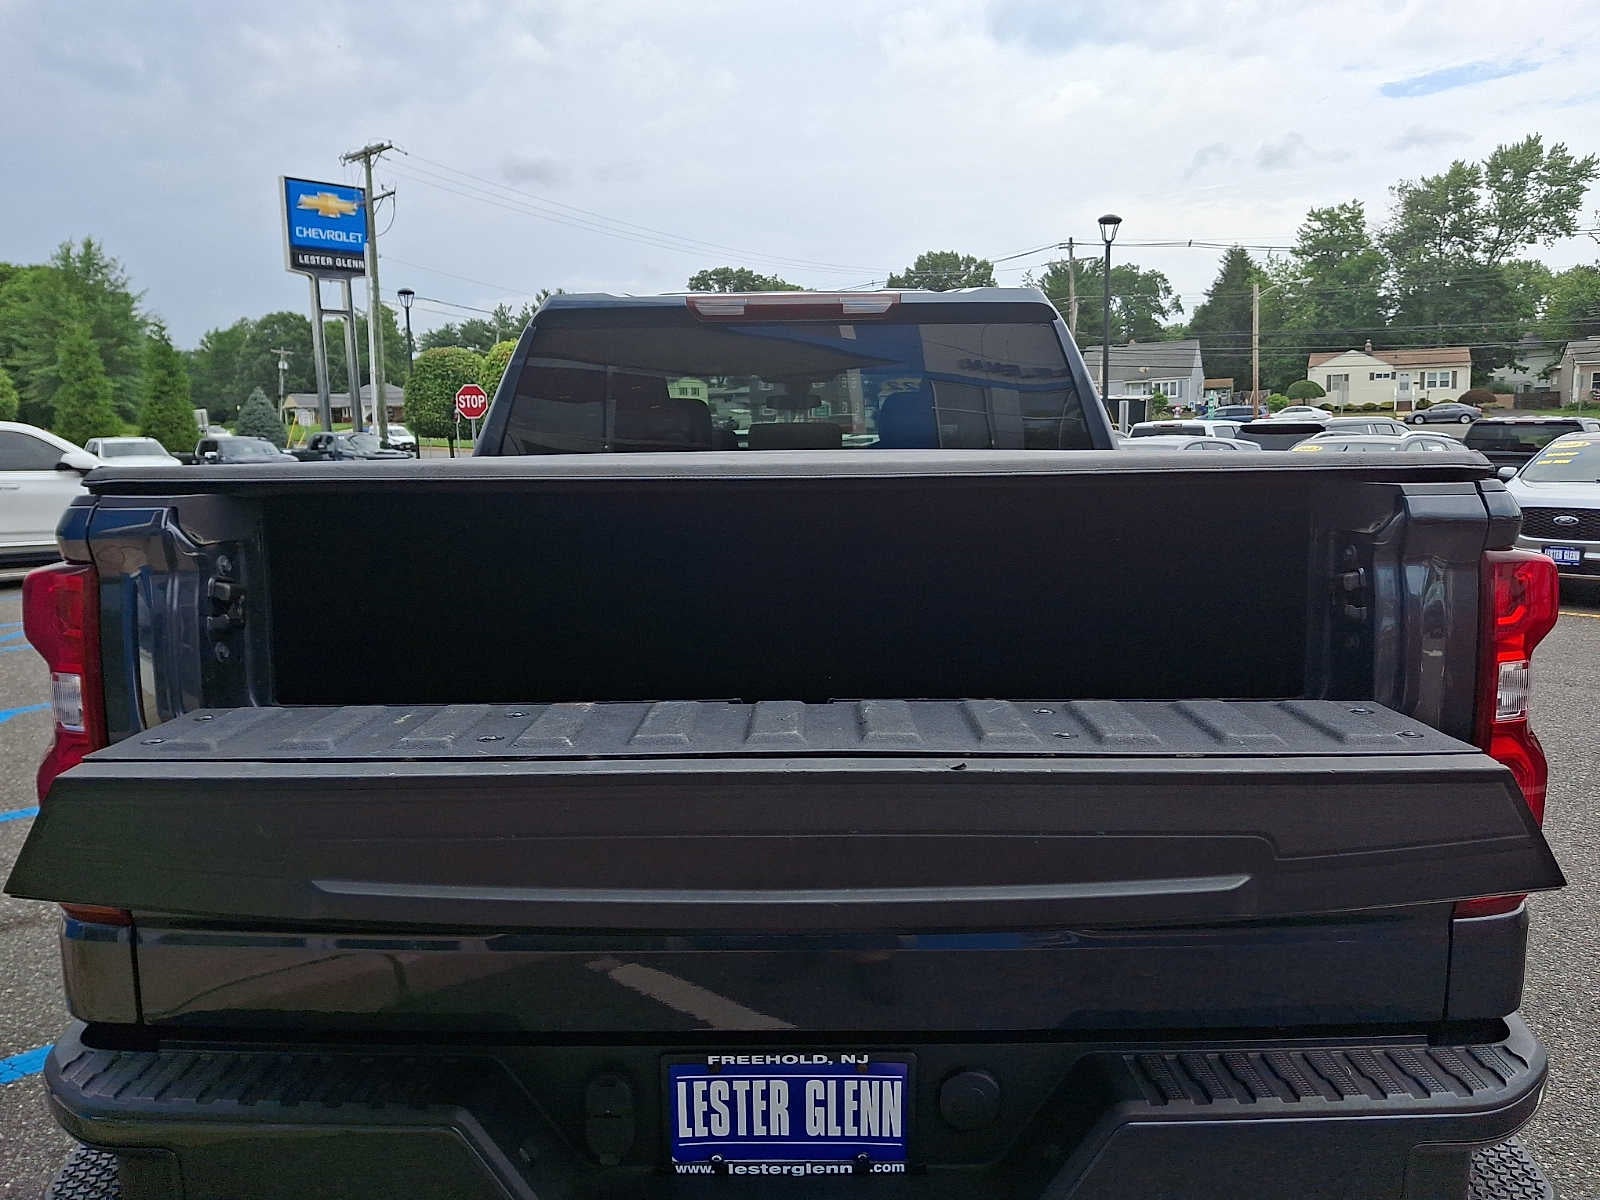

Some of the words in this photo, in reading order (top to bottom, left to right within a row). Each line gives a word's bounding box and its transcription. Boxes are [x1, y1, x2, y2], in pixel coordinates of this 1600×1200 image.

[295, 226, 363, 243] CHEVROLET
[298, 253, 333, 266] LESTER
[335, 257, 365, 269] GLENN
[458, 394, 485, 409] STOP
[707, 1054, 833, 1066] FREEHOLD,
[840, 1054, 869, 1064] NJ
[677, 1079, 790, 1138] LESTER
[805, 1079, 903, 1138] GLENN
[675, 1164, 716, 1174] www.
[728, 1163, 853, 1176] lesterglenn
[869, 1162, 905, 1174] .com
